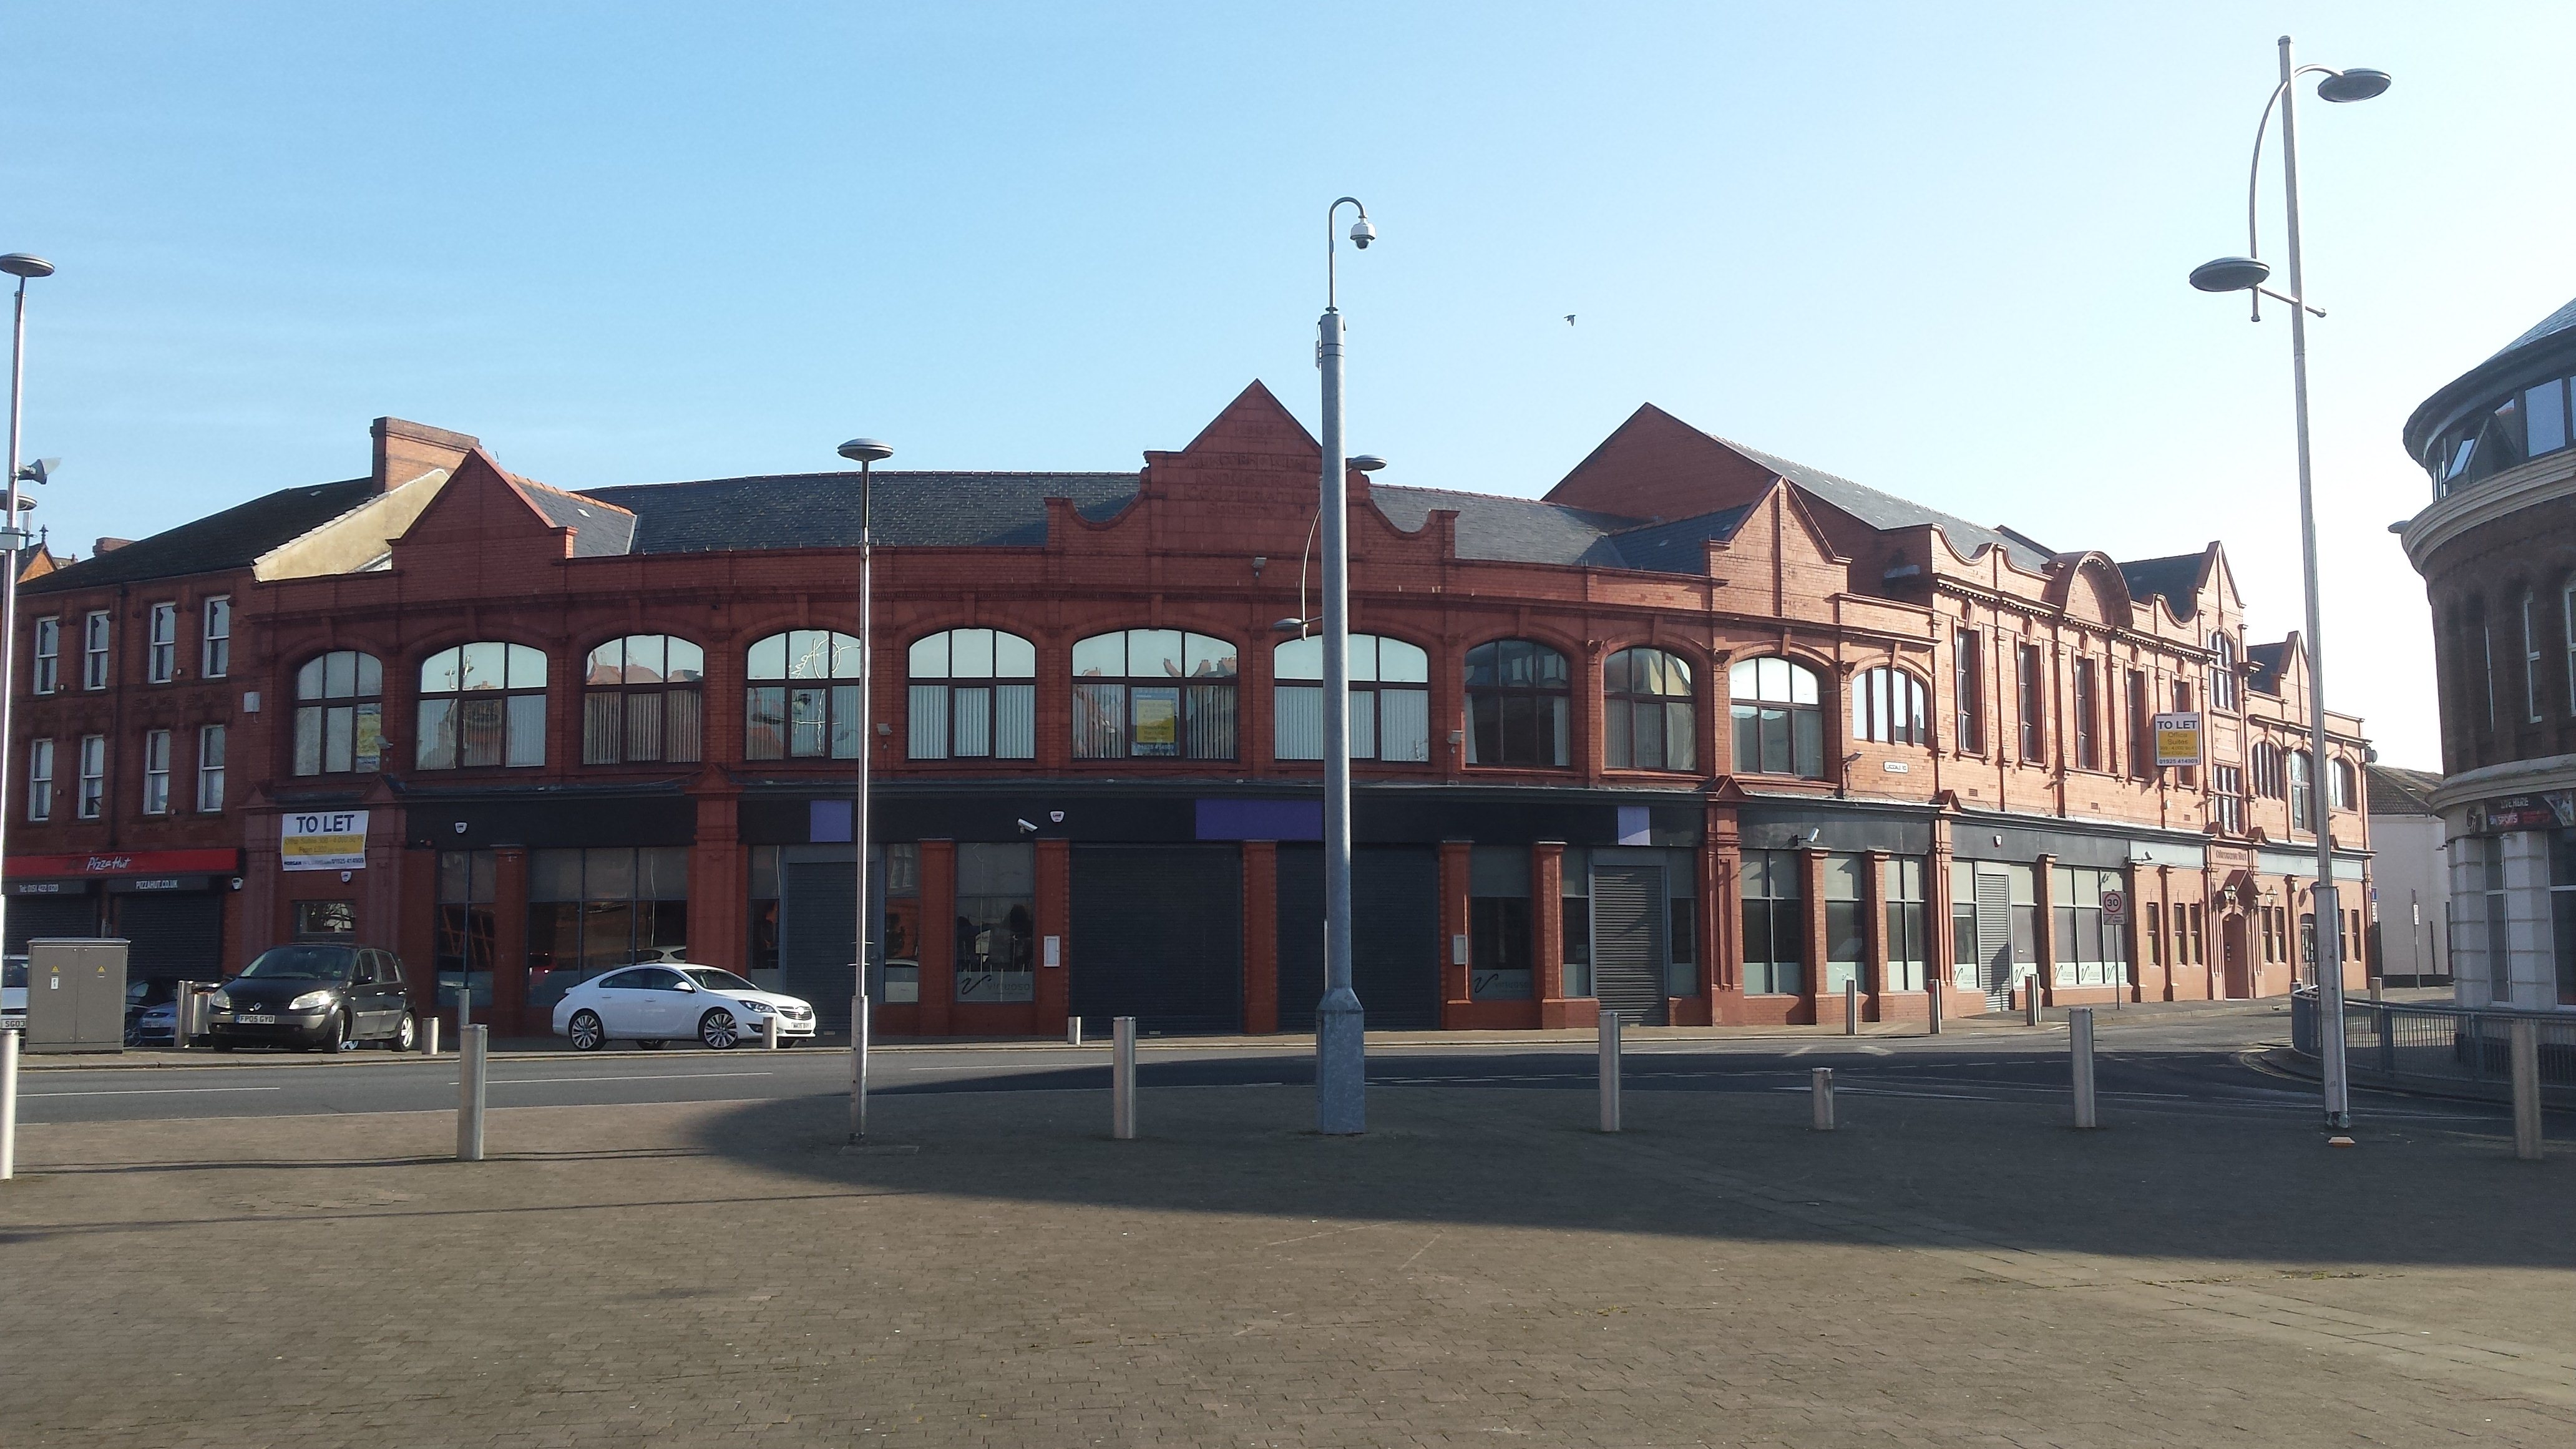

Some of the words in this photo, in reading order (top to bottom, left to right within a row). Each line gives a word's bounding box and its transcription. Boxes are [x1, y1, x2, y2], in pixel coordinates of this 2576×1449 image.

[2157, 721, 2173, 729] TO
[2176, 720, 2197, 729] LET
[2512, 798, 2529, 807] HERE
[296, 816, 318, 833] TO
[323, 814, 354, 832] LET
[86, 857, 111, 871] Pizza
[112, 856, 132, 869] Hut
[135, 879, 178, 889] PIZZAHUT.CO.UK
[2107, 899, 2119, 907] 30
